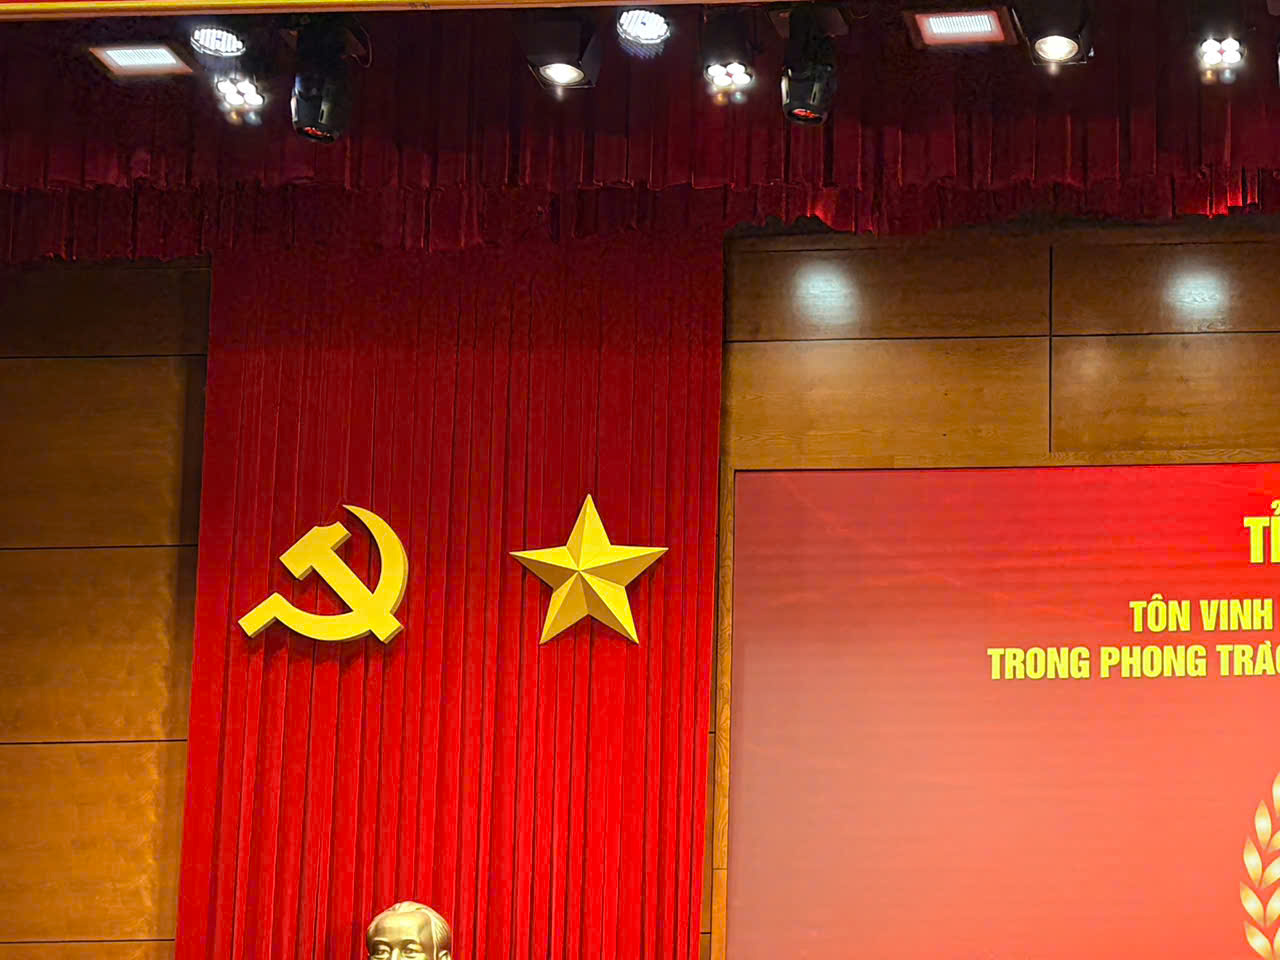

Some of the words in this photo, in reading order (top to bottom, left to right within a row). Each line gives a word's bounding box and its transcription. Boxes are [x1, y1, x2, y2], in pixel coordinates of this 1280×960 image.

[1129, 593, 1191, 632] TÔN
[1199, 597, 1273, 631] VINH
[986, 646, 1090, 680] TRONG
[1100, 644, 1207, 678] PHONG
